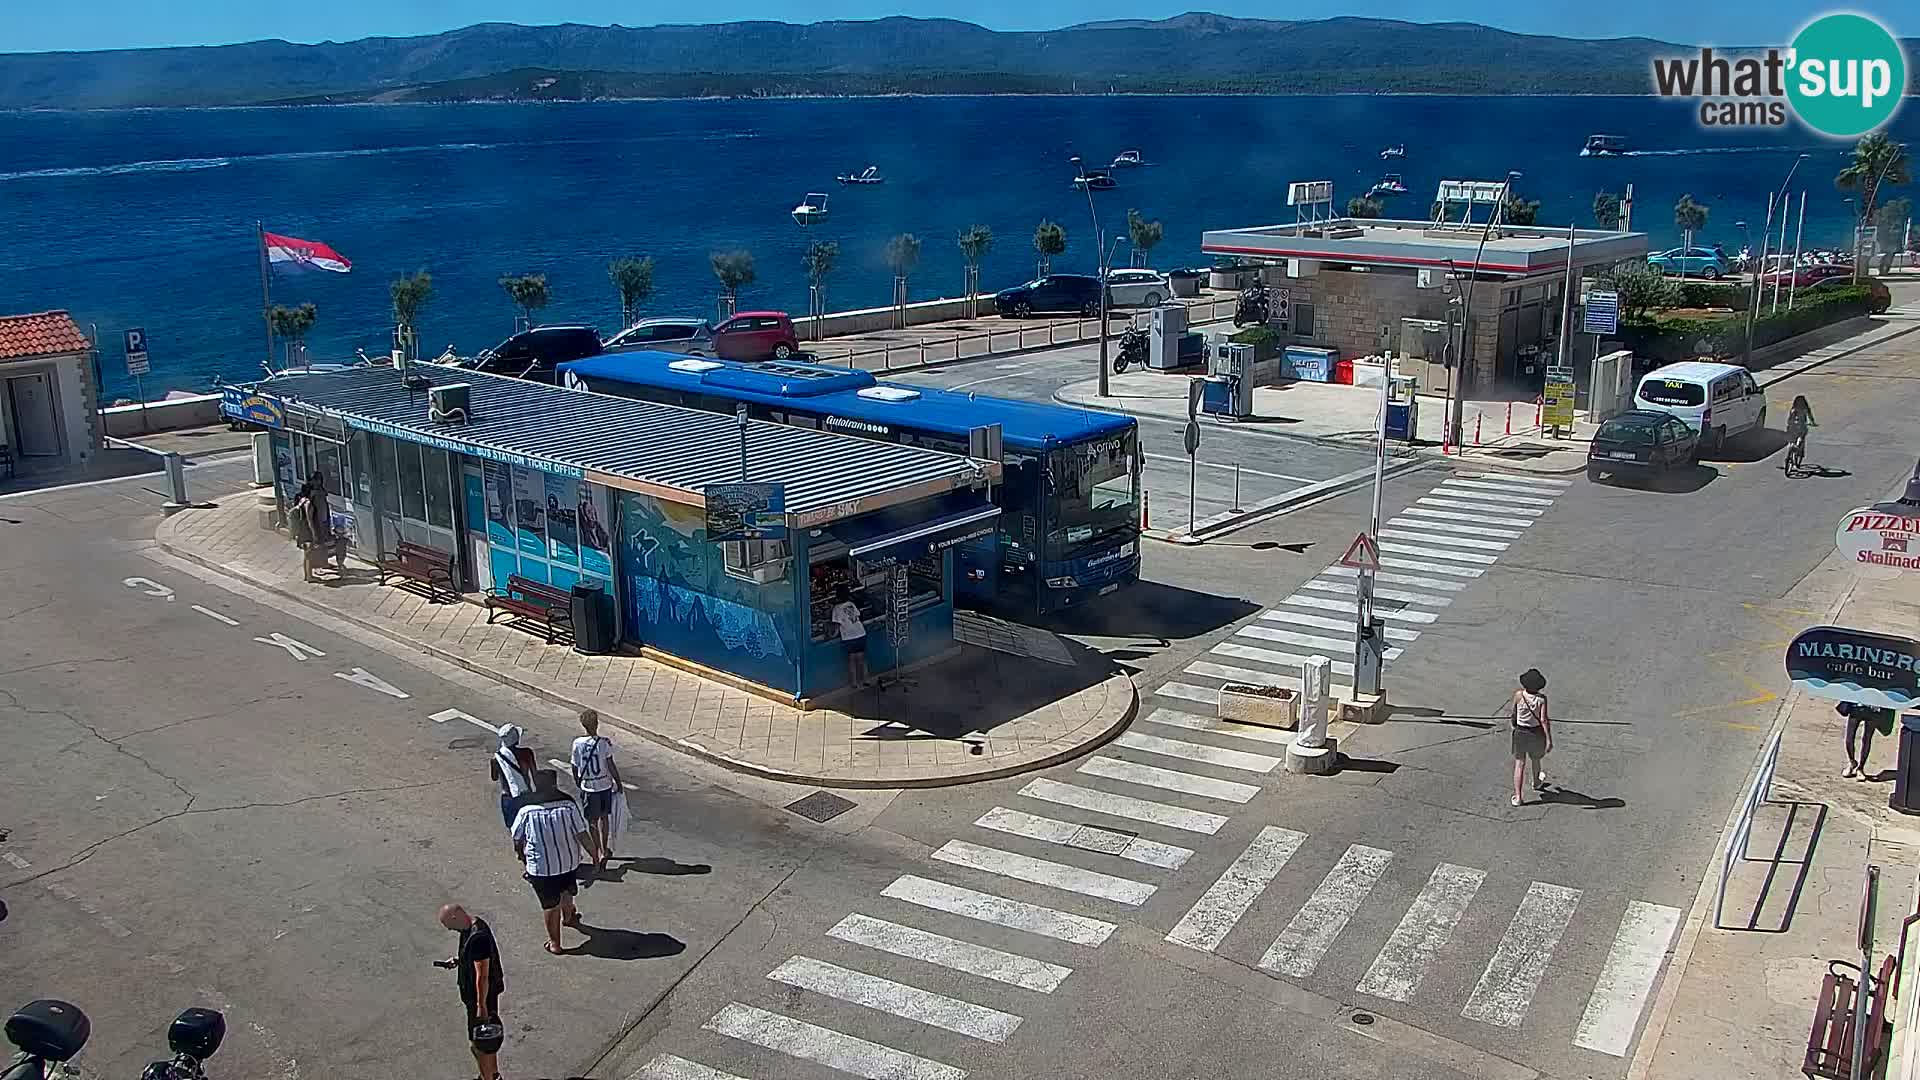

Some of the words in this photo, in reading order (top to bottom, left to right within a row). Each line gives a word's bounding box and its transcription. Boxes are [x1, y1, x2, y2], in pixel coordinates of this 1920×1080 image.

[1664, 380, 1683, 389] TAXI
[477, 447, 491, 458] BUS
[492, 450, 525, 465] STATION
[527, 457, 552, 472] TICKET
[554, 462, 582, 477] OFFICE
[1826, 662, 1863, 675] caffe
[1868, 665, 1895, 680] bar
